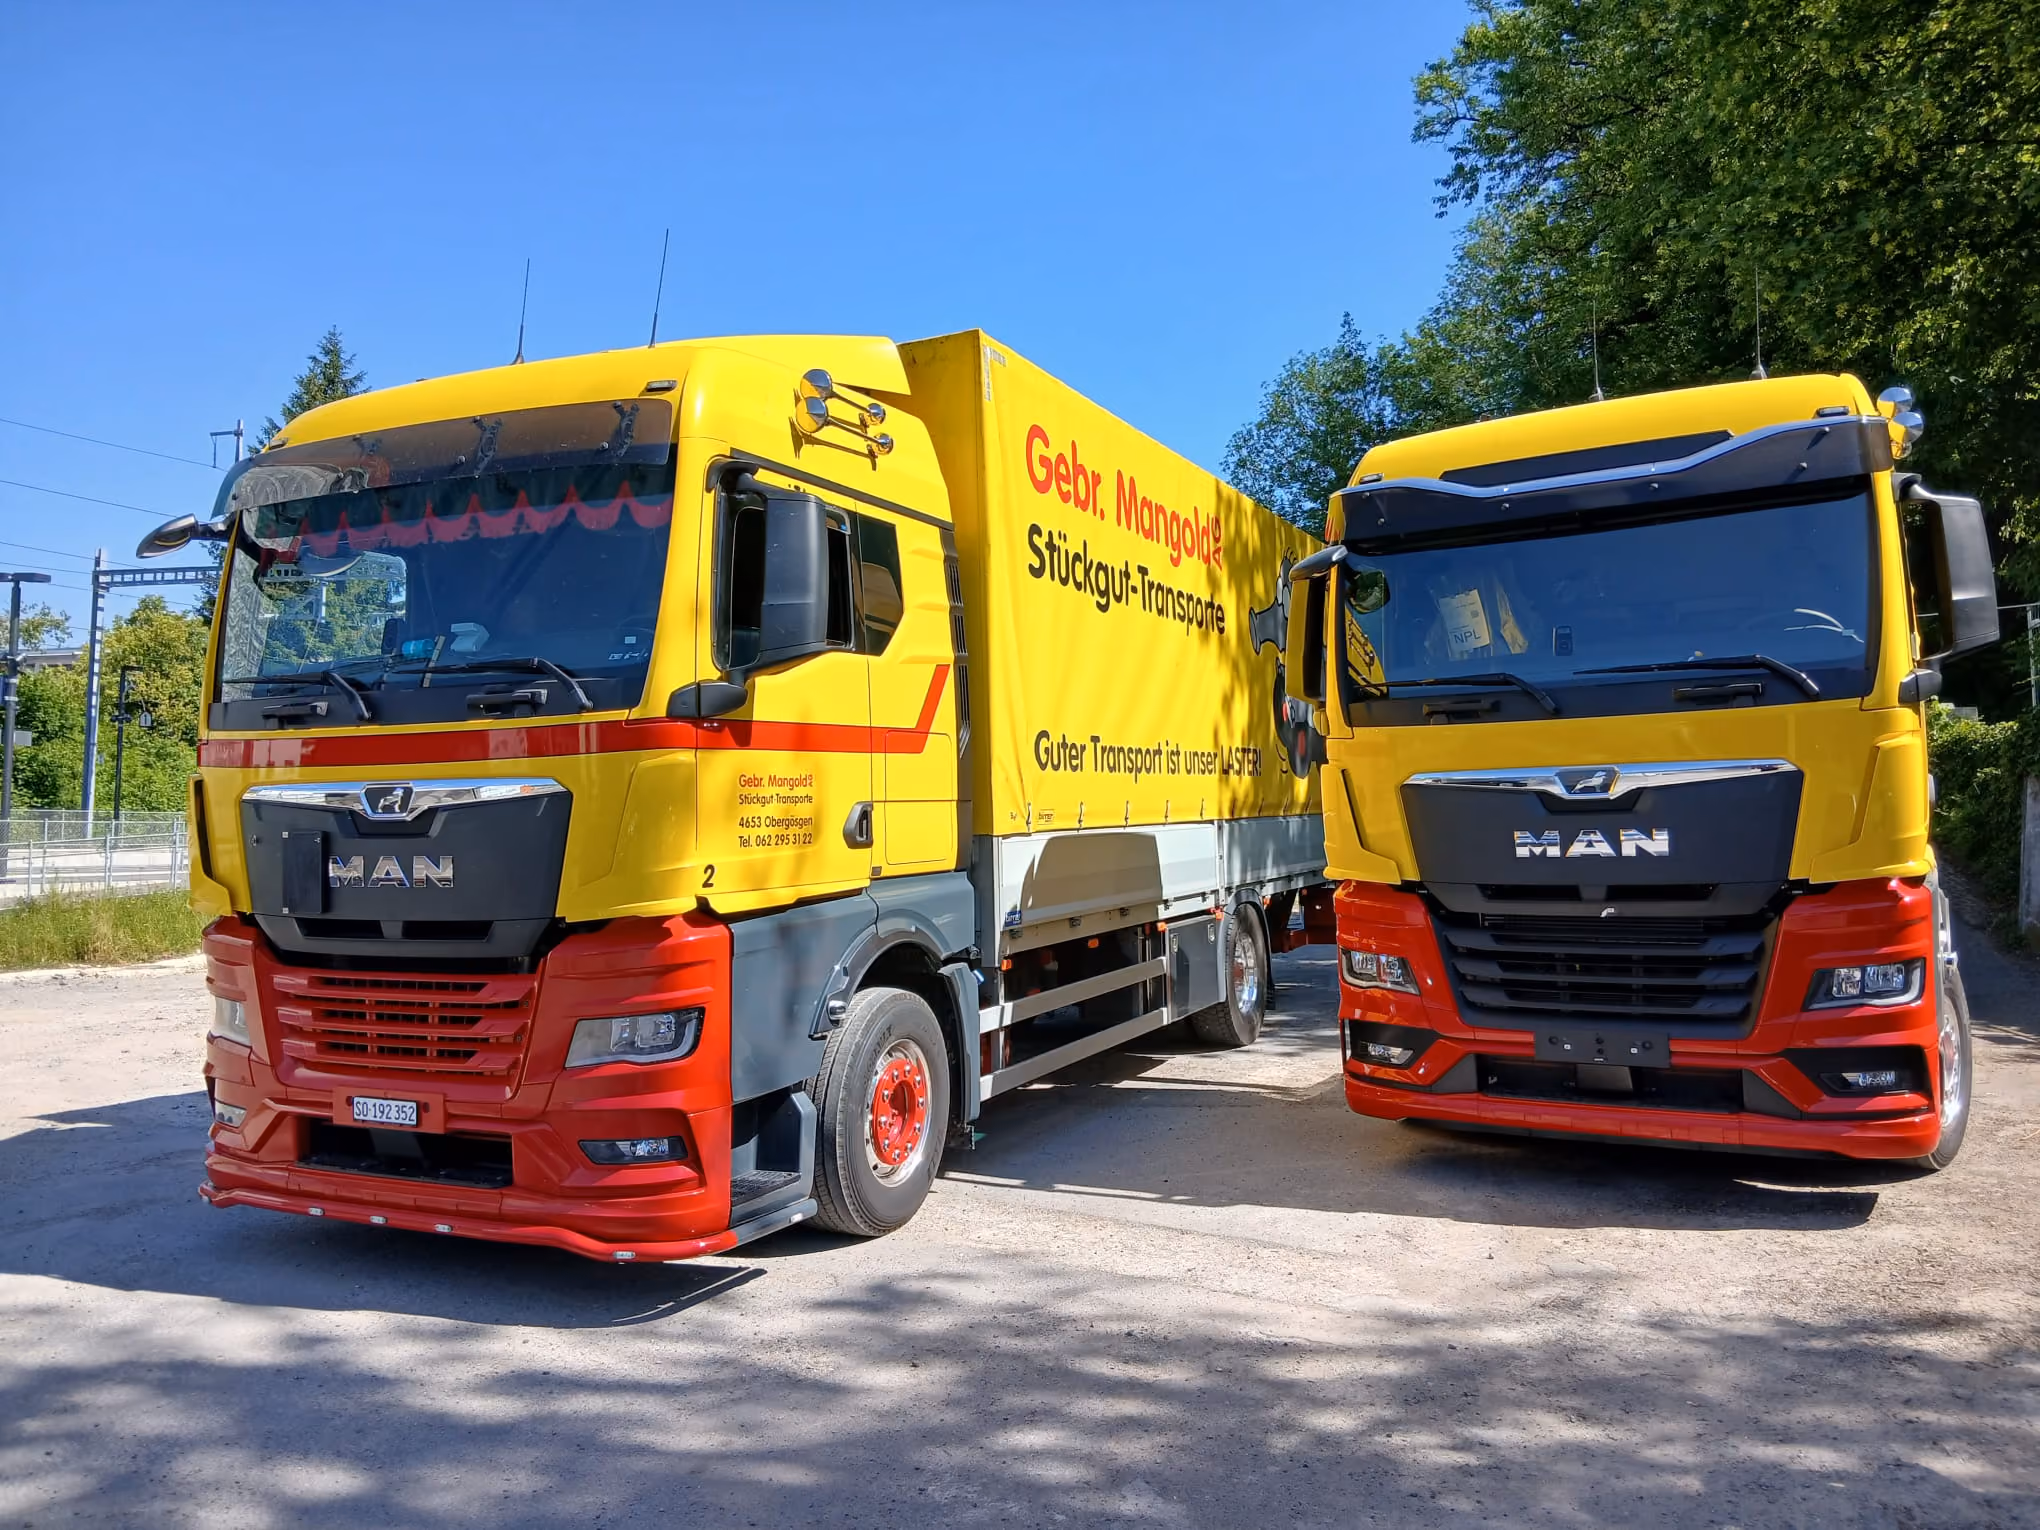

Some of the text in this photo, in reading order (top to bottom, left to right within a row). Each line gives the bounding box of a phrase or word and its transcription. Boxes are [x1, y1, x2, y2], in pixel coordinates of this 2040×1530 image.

[1026, 424, 1222, 571] Gebr. Mangold AG
[1028, 523, 1225, 636] Stückgut-Transporte
[1453, 629, 1481, 644] NPL
[1034, 730, 1262, 784] Guter Transport ist unser LASTER!
[739, 774, 764, 787] Gebr.
[768, 774, 807, 790] Mangold
[738, 793, 813, 807] Stückgut-Transporte
[739, 815, 812, 830] 4653 Obergösgen
[738, 834, 752, 848] Tel.
[755, 834, 772, 847] 062
[774, 833, 790, 845] 295
[1513, 828, 1669, 858] MAN
[328, 855, 454, 888] MAN
[702, 864, 715, 888] 2
